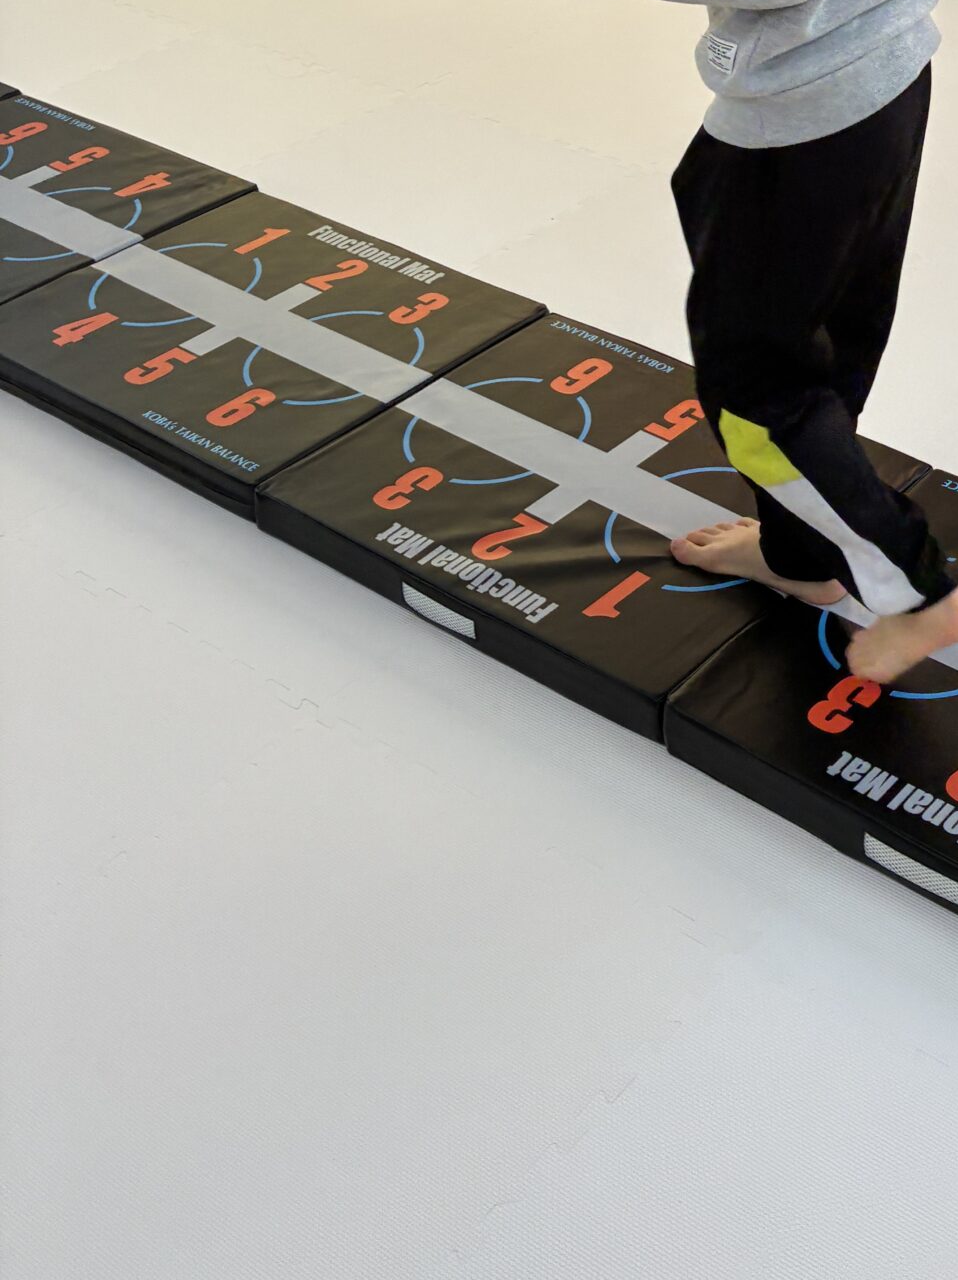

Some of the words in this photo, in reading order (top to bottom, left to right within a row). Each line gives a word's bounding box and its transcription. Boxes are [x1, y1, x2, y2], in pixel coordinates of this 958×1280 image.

[48, 146, 110, 172] 5
[114, 172, 172, 197] 4
[234, 227, 291, 255] 1
[307, 225, 403, 270] Functional
[400, 261, 447, 285] Mat
[304, 259, 369, 291] 2
[388, 292, 449, 325] 3
[52, 312, 119, 347] 4
[549, 320, 598, 342] BALANCE
[596, 338, 637, 359] TAIKAN
[123, 347, 198, 385] 5
[550, 357, 613, 395] 6
[206, 388, 276, 427] 6
[644, 399, 706, 441] 5
[175, 426, 215, 451] TAIKAN
[210, 443, 260, 473] BALANCE
[372, 466, 444, 510] 3
[375, 522, 434, 559] Mat
[471, 513, 548, 561] 2
[421, 549, 559, 623] Functional
[582, 571, 651, 618] 1
[807, 674, 882, 734] 3
[826, 750, 898, 802] Mat
